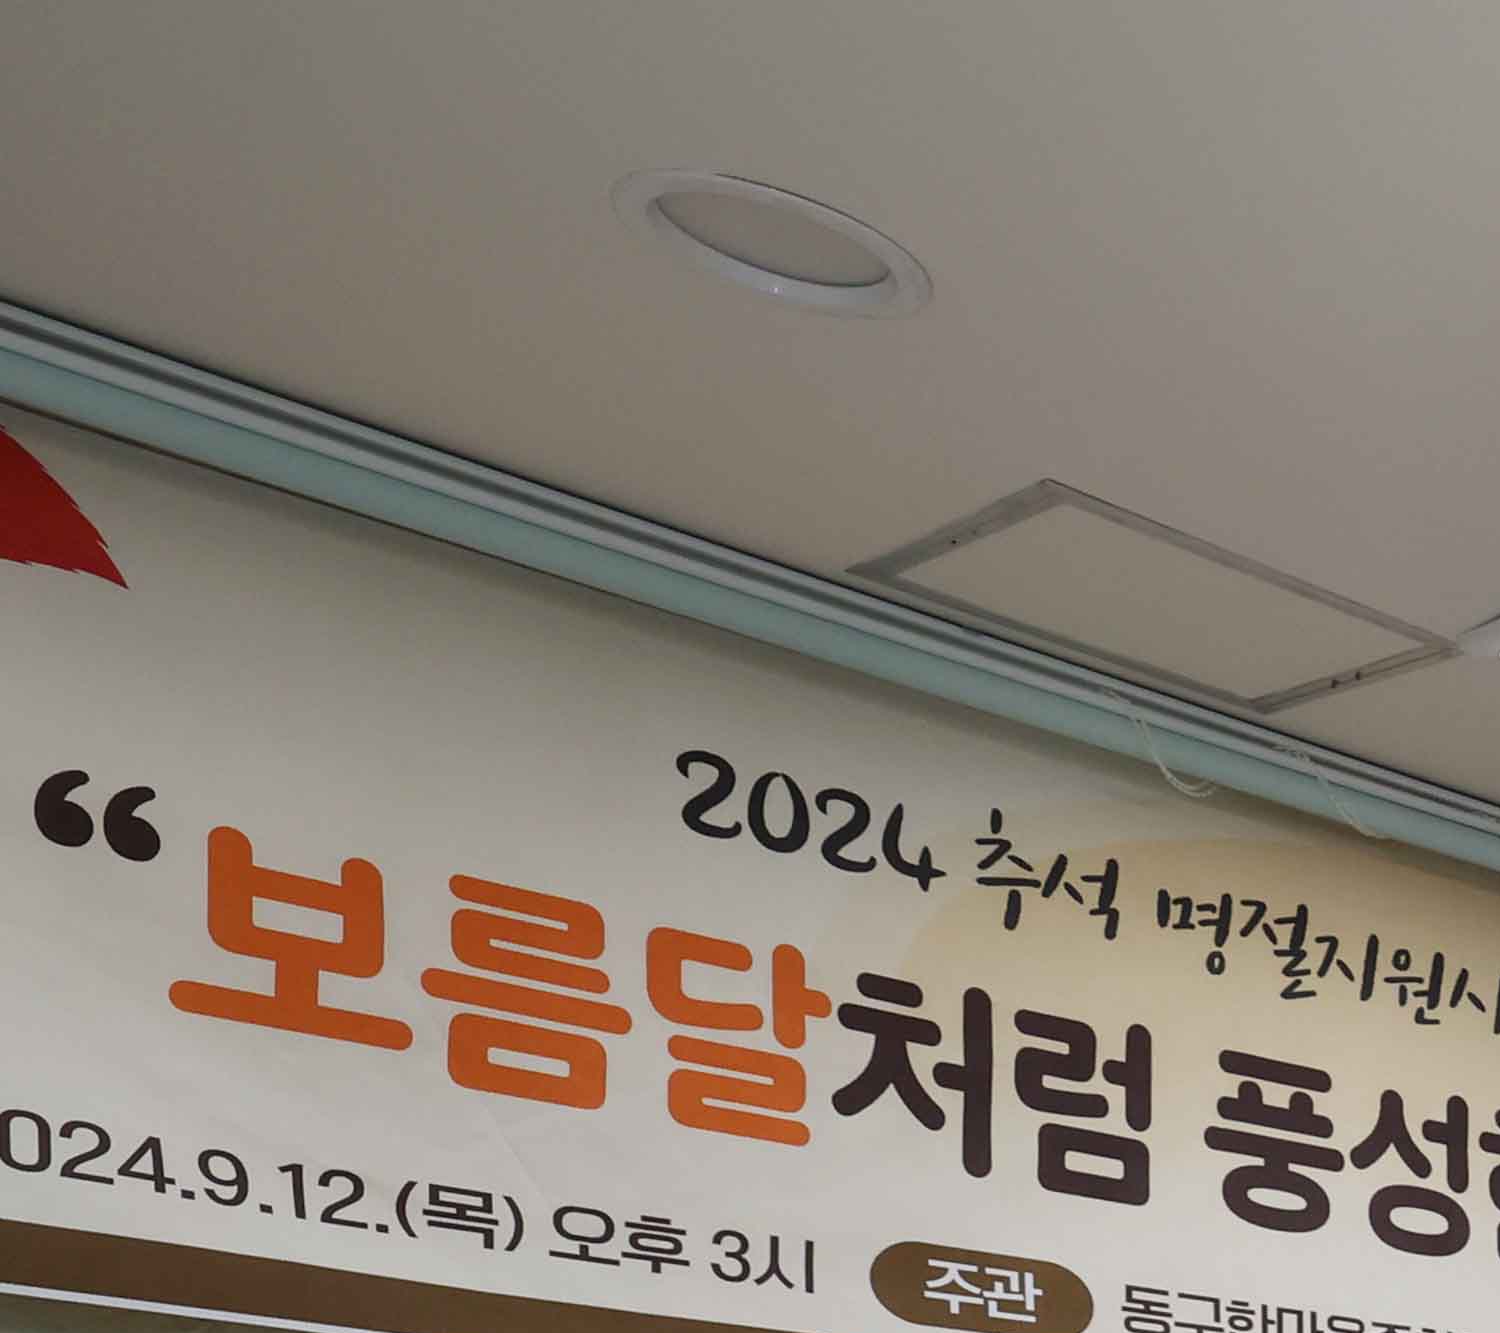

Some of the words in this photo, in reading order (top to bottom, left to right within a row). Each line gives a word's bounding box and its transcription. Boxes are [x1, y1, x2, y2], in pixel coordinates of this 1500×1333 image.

[675, 749, 947, 891] 2024
[975, 807, 1120, 939] 추석
[548, 1203, 691, 1275] 오후
[711, 1231, 816, 1296] 3시
[922, 1257, 1044, 1327] 주관
